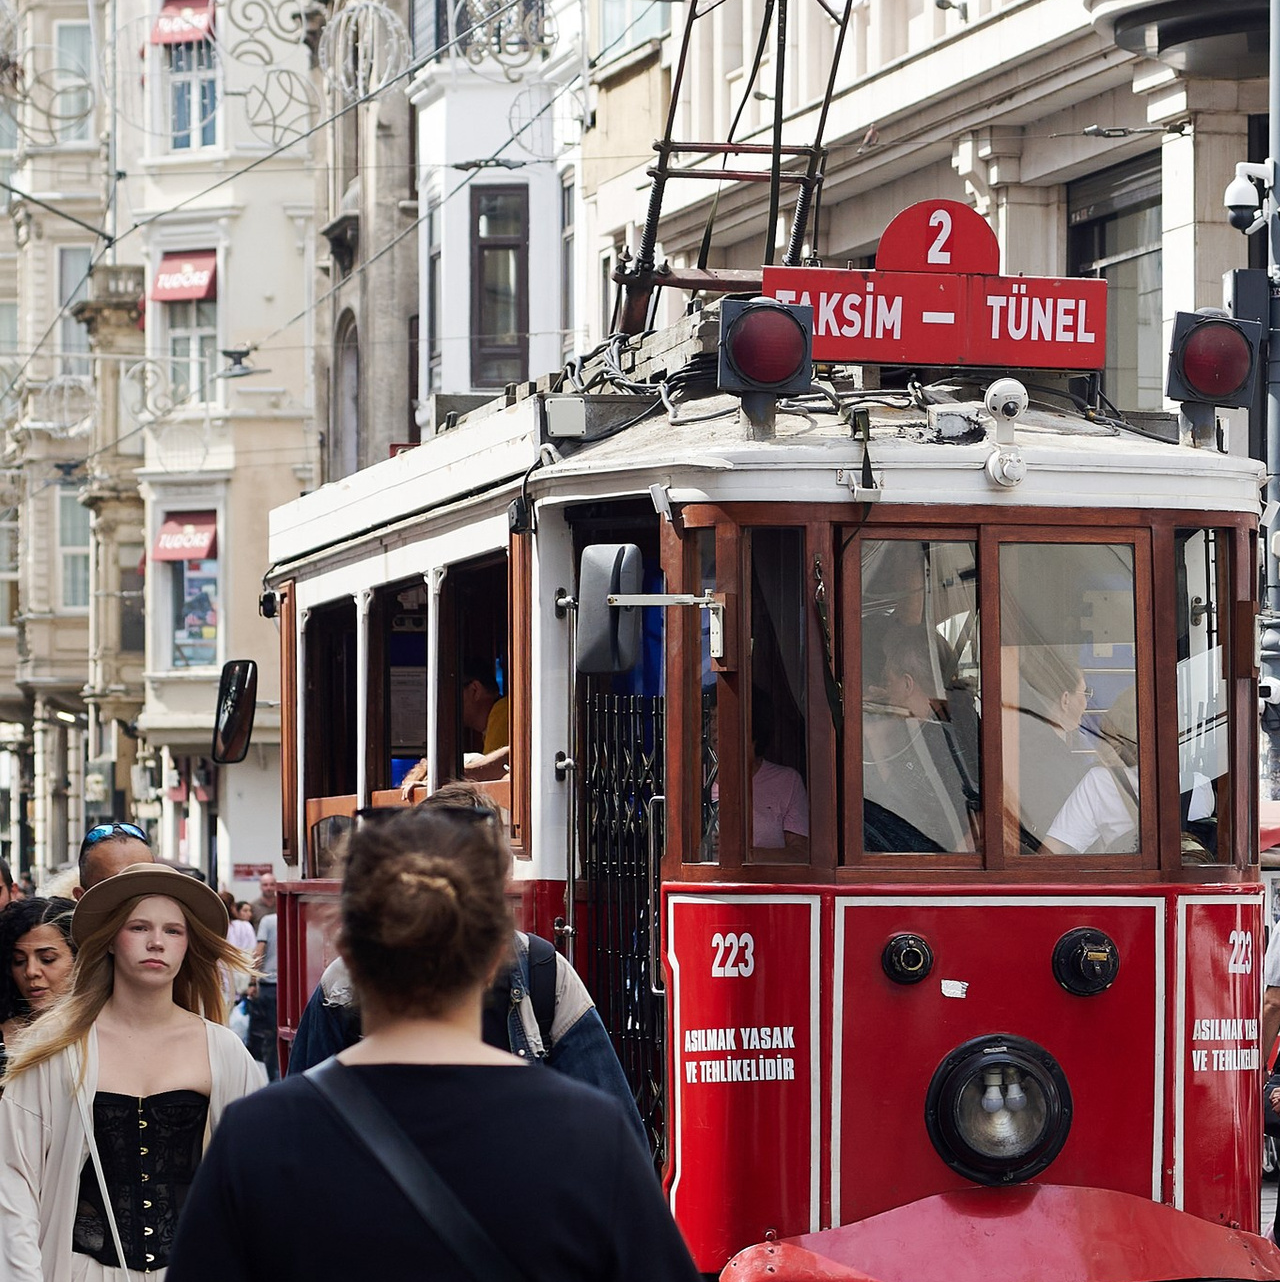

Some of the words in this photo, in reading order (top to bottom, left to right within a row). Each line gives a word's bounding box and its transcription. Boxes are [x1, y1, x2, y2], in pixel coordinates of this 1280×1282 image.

[927, 209, 952, 264] 2
[987, 283, 1096, 343] TÜNEL
[159, 531, 211, 549] TUDORS
[711, 932, 755, 977] 223
[1228, 930, 1252, 975] 223
[685, 1028, 736, 1052] ASILMAK
[740, 1027, 795, 1049] YASAK
[1192, 1019, 1243, 1040] ASILMAK
[685, 1062, 697, 1083] VE
[700, 1054, 795, 1083] TEHLİKELİDİR
[1192, 1050, 1207, 1071] VE
